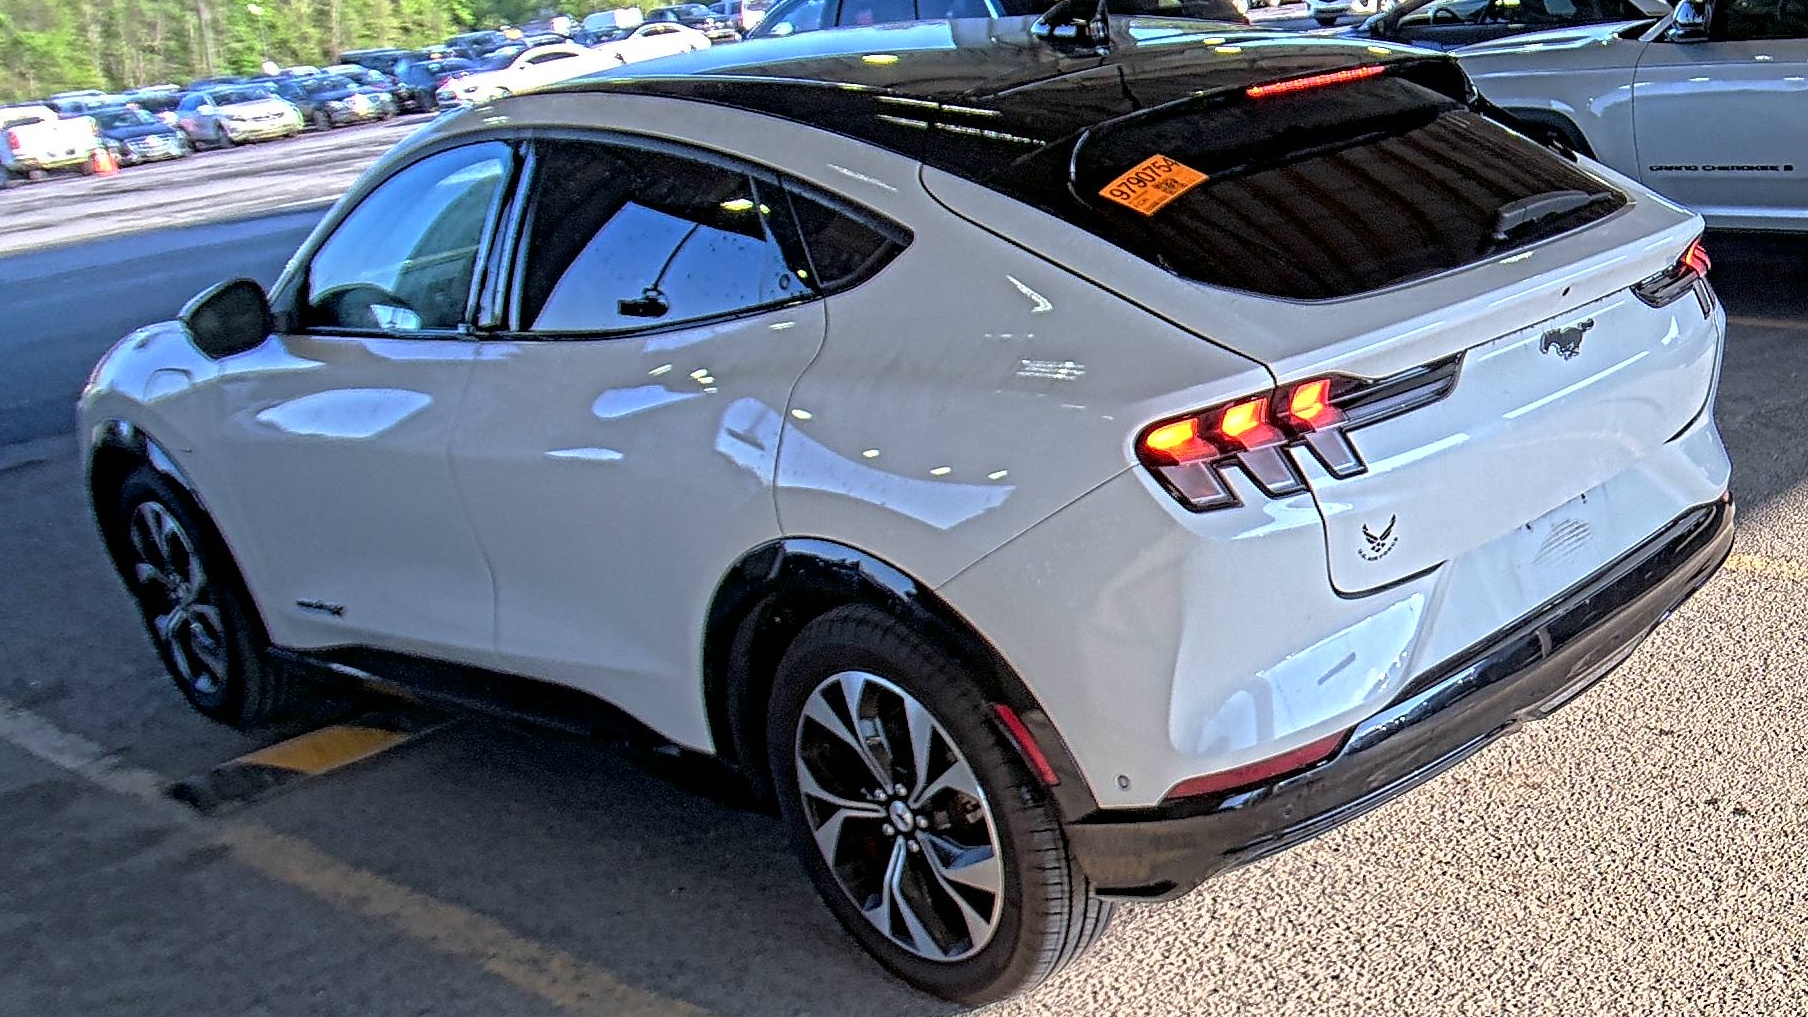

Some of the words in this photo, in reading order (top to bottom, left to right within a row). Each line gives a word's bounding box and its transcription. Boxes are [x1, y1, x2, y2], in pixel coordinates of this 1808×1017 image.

[1109, 157, 1180, 201] 9790754
[1649, 164, 1699, 172] GRAND
[1701, 164, 1779, 172] CHEROKEE
